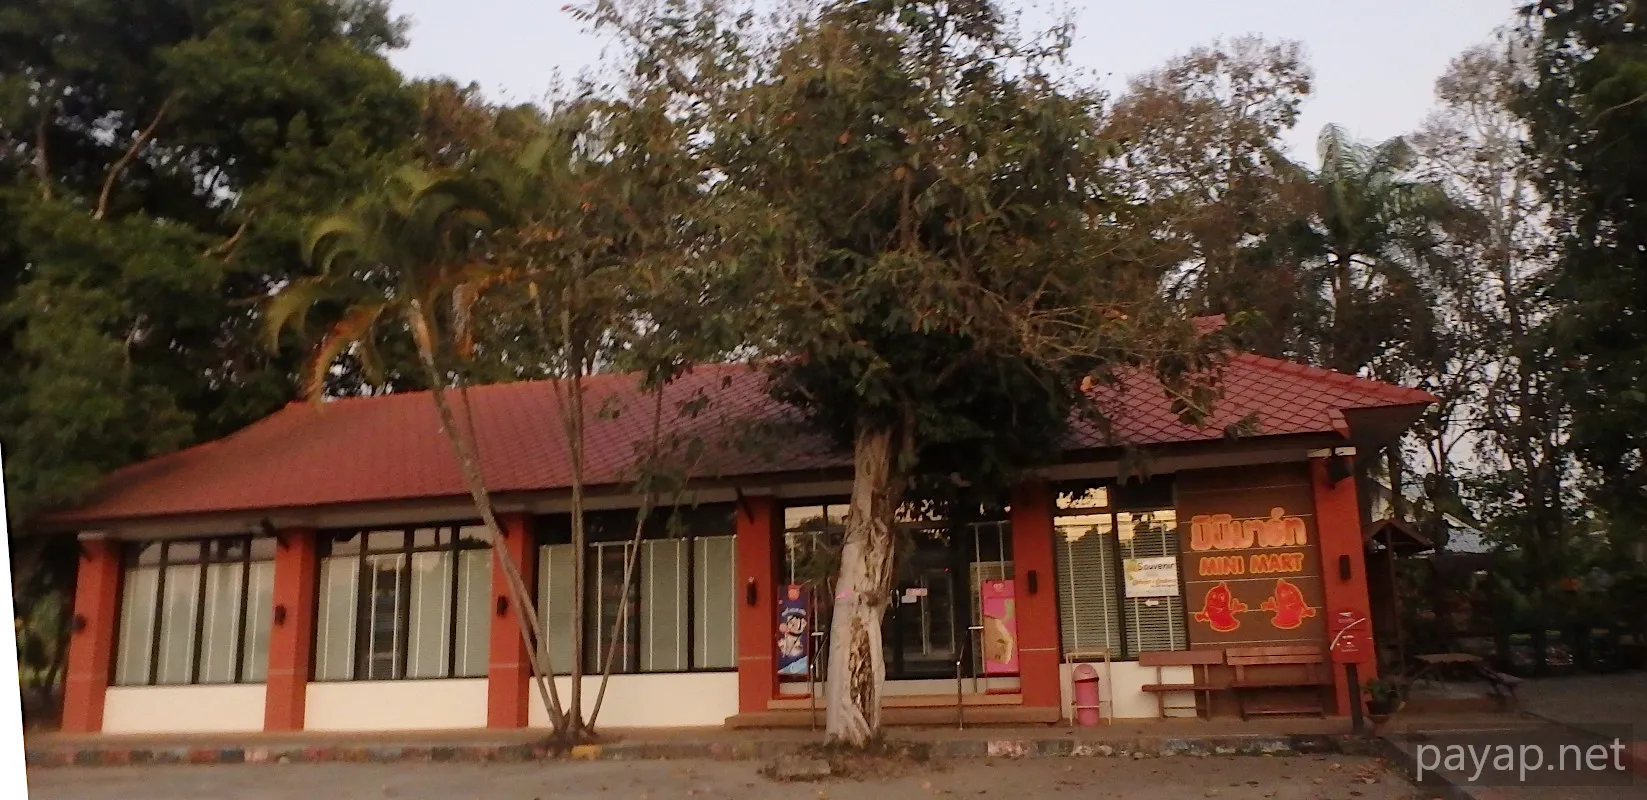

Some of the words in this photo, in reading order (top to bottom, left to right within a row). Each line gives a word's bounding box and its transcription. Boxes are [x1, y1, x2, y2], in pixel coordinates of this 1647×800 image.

[1137, 562, 1175, 571] Souvenir
[1199, 555, 1244, 576] MINI
[1250, 553, 1304, 573] MART
